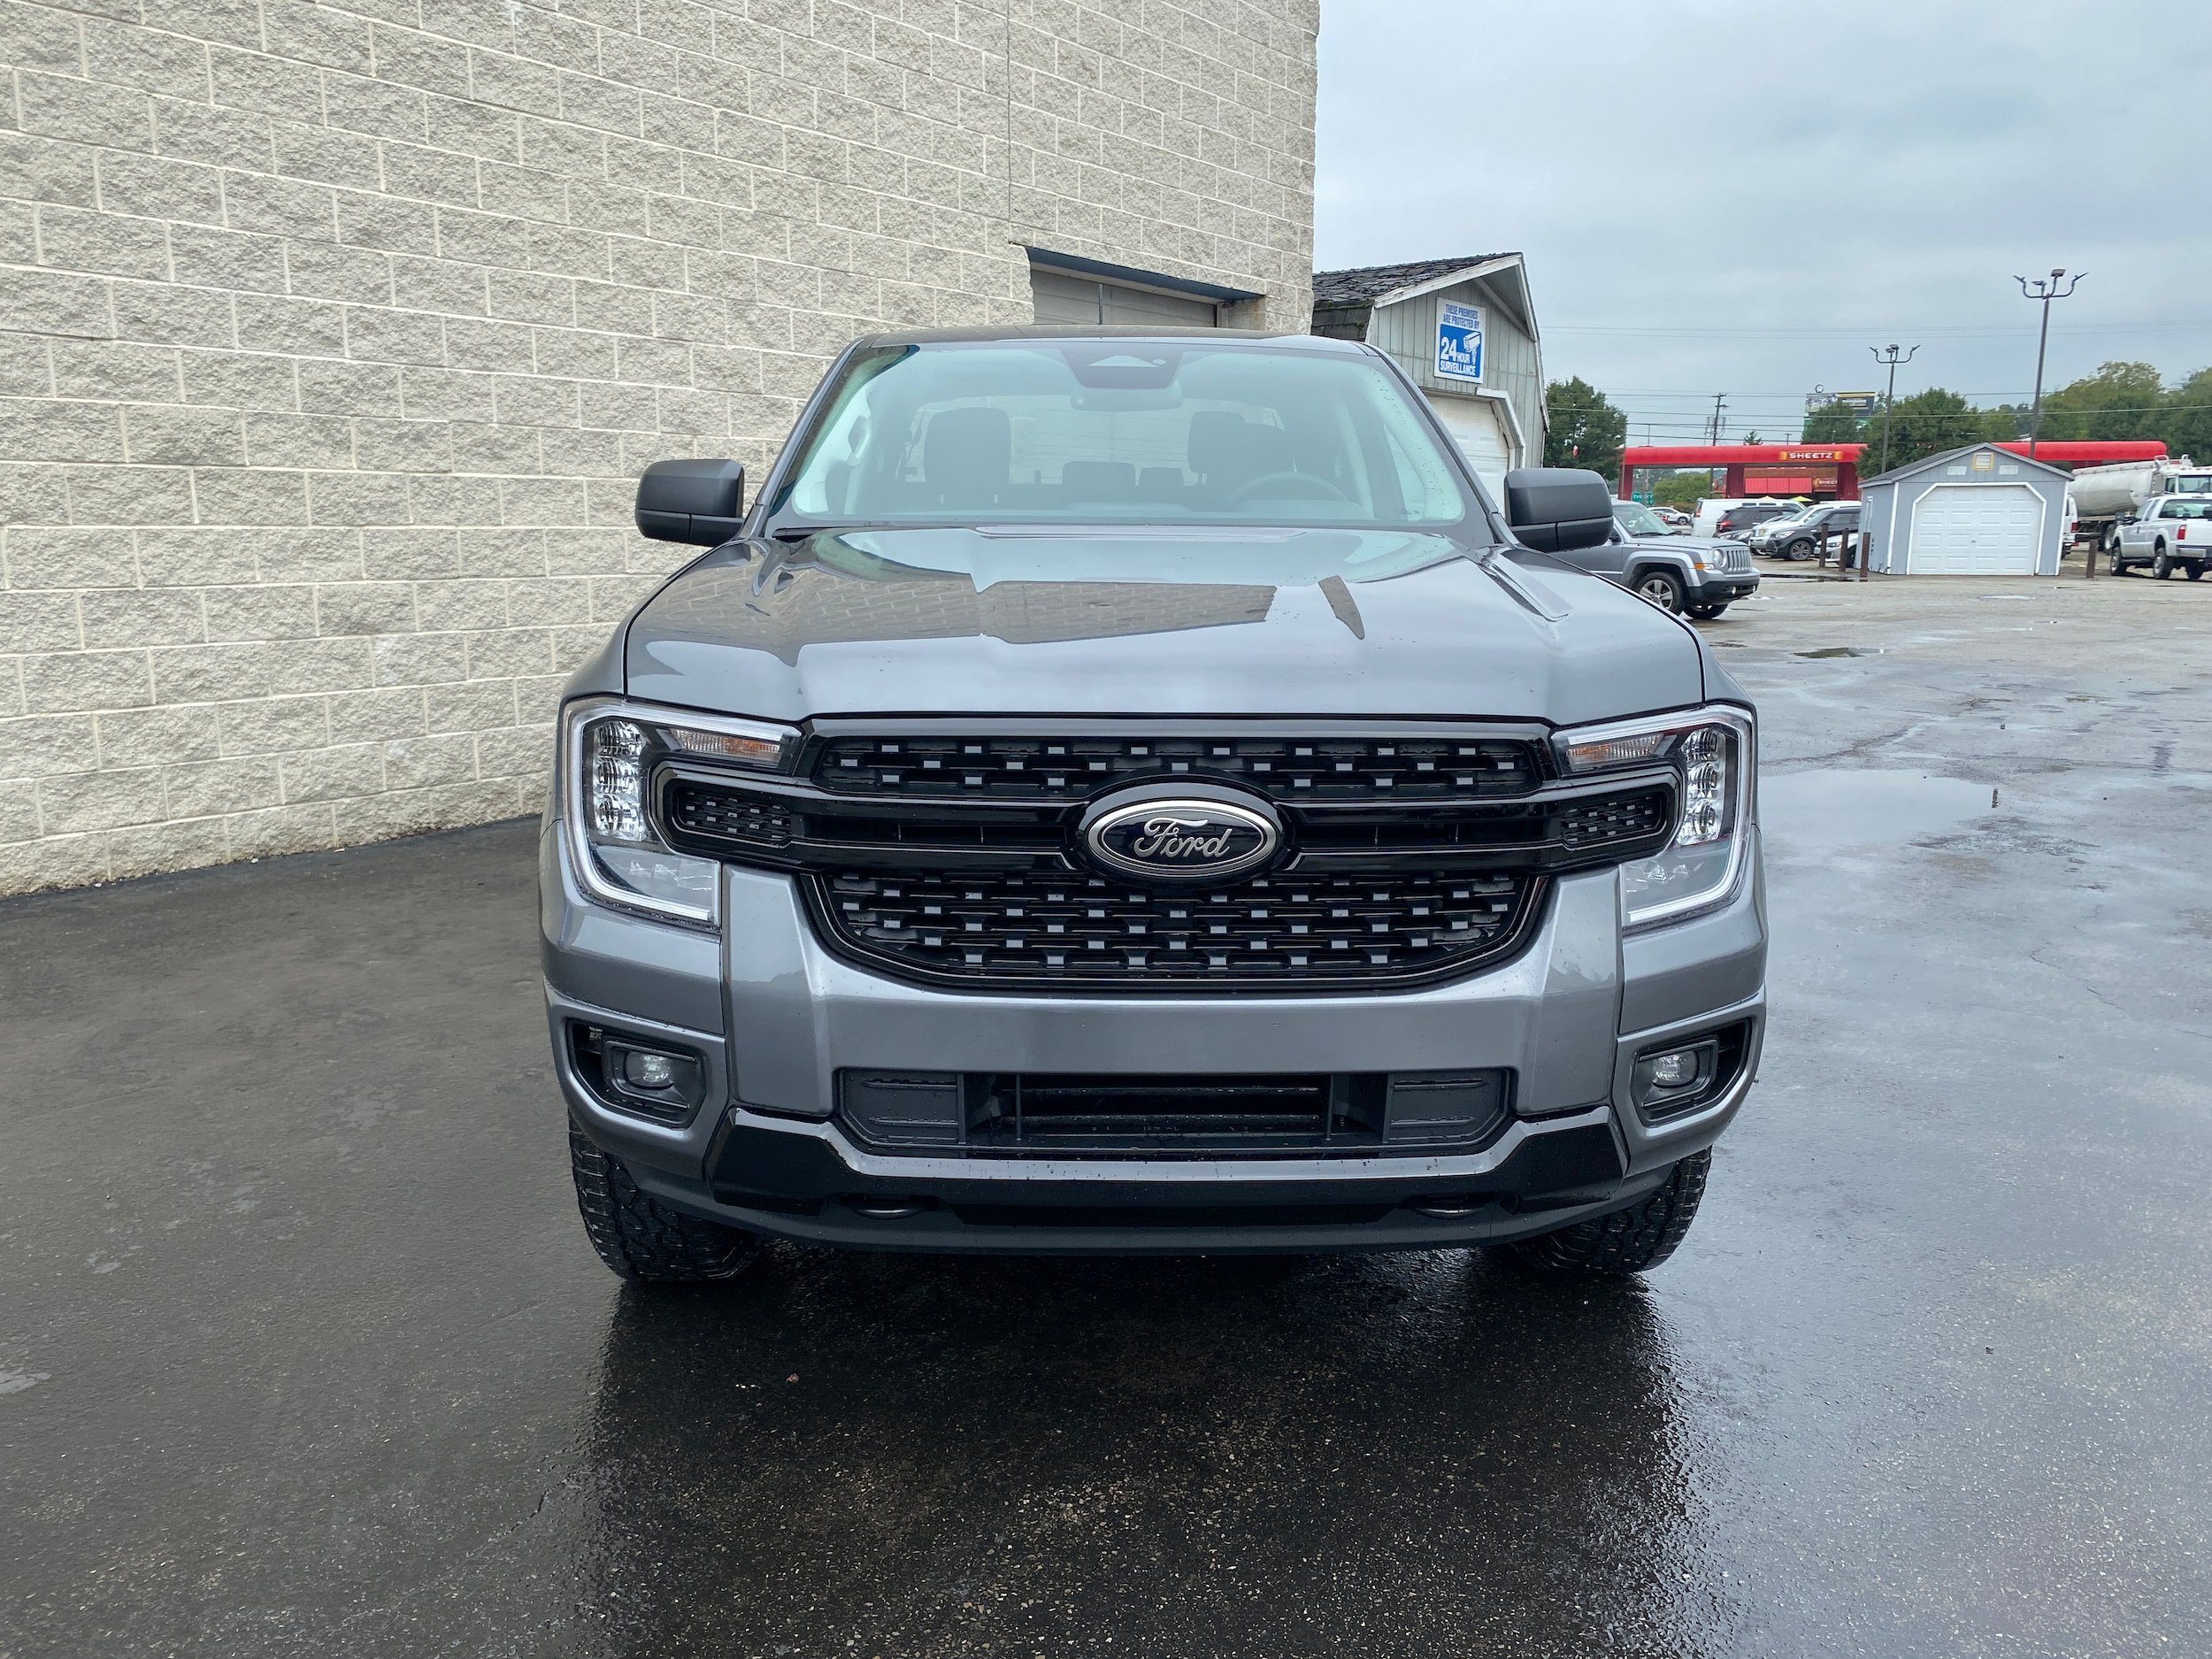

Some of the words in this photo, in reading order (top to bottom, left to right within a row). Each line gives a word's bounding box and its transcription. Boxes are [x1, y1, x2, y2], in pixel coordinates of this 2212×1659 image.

[1446, 304, 1458, 315] THESE
[1458, 307, 1478, 319] PREMISES
[1451, 315, 1474, 328] PROTECTED
[1474, 320, 1479, 329] BY
[1440, 336, 1456, 361] 24
[1457, 352, 1470, 364] HOUR
[1440, 360, 1476, 375] SURVEILLANCE
[1133, 817, 1233, 858] Ford
